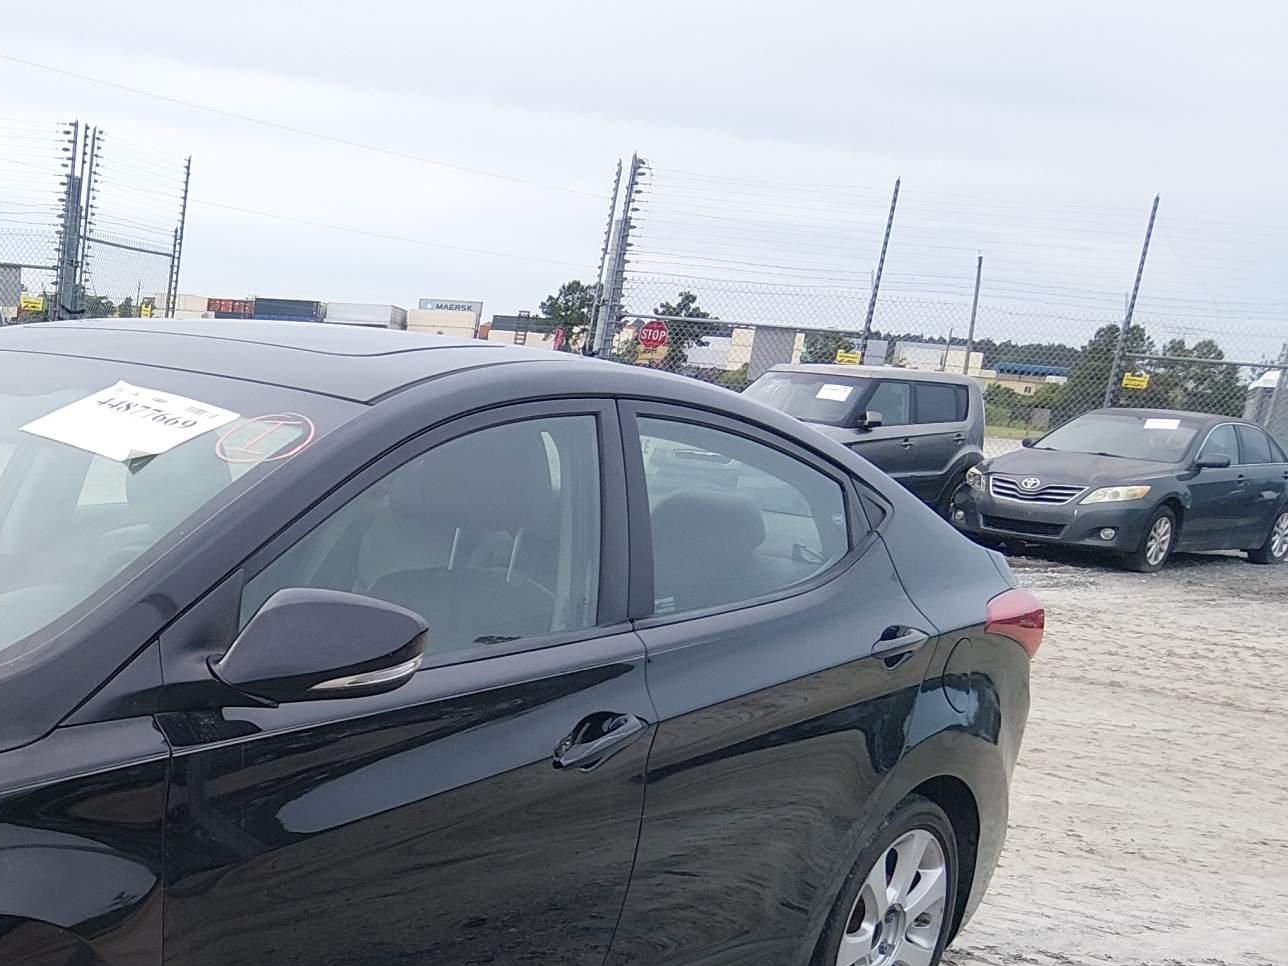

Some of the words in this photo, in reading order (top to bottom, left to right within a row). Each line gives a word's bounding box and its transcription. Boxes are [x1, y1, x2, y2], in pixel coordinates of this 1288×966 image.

[434, 303, 473, 312] MAERSK
[641, 328, 667, 341] STOP
[96, 397, 198, 429] 44877669
